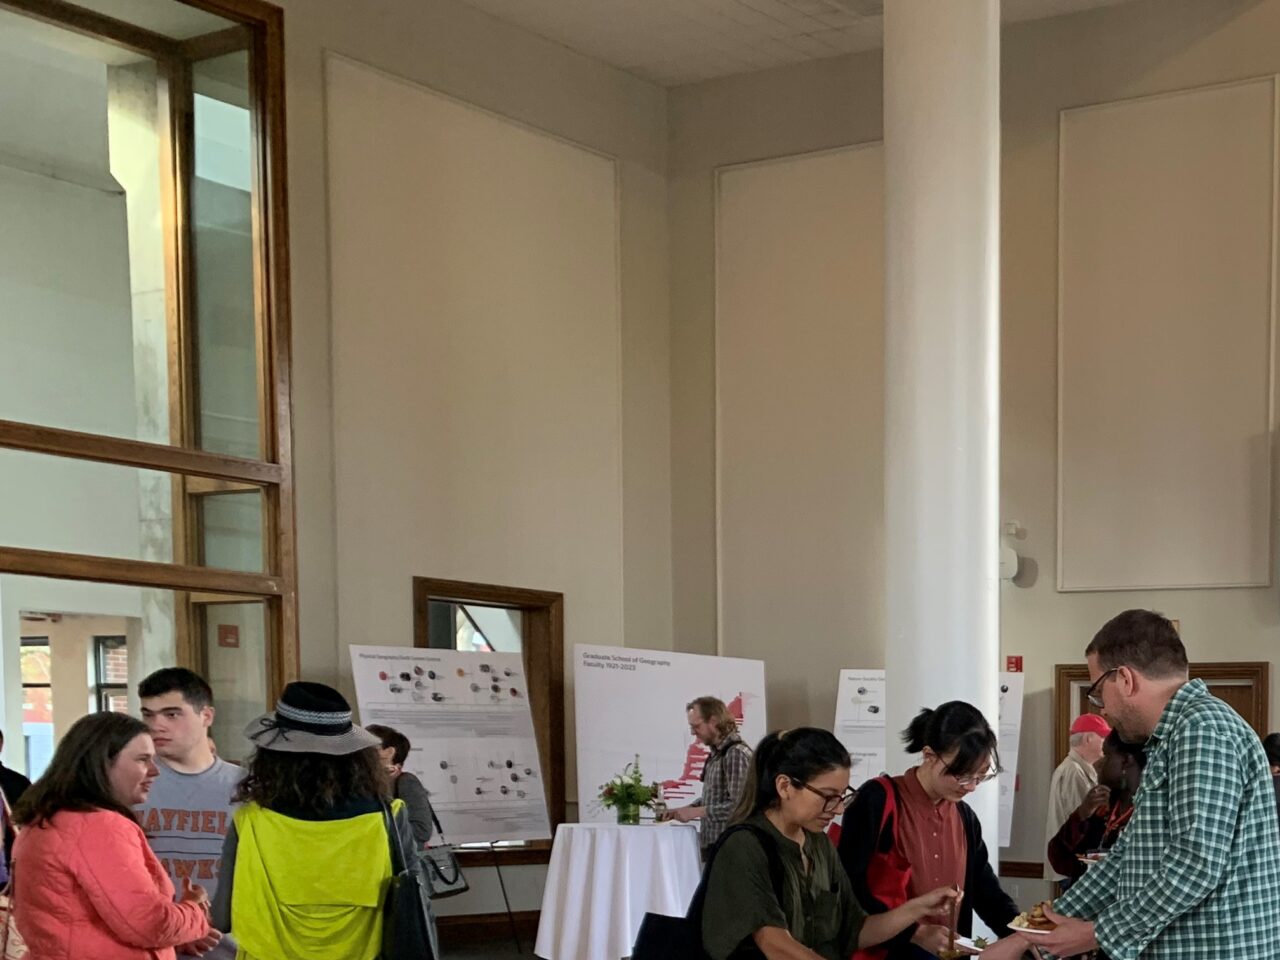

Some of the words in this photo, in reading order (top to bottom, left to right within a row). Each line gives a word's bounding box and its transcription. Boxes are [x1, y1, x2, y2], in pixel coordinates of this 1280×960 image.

[582, 652, 610, 661] Graduate
[612, 655, 631, 663] School
[639, 658, 671, 667] Geography
[583, 660, 604, 669] Faculty
